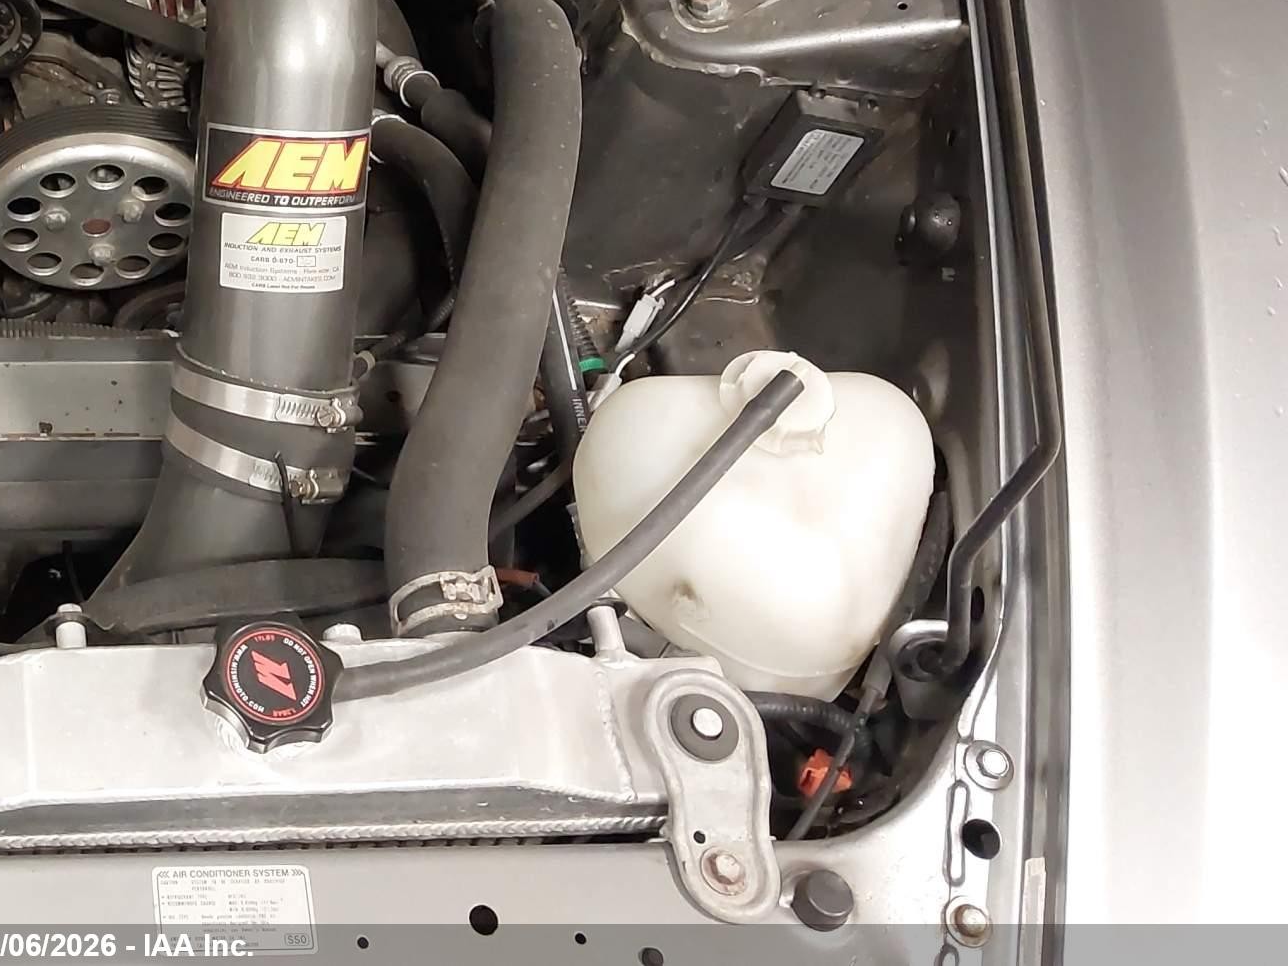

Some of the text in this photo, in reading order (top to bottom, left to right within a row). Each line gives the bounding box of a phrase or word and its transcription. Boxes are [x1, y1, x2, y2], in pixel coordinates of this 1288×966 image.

[211, 136, 368, 194] AEM
[209, 188, 270, 203] ENGINEERED
[274, 195, 290, 206] TO
[245, 221, 326, 246] AEM
[224, 242, 258, 252] INDUCTION
[315, 245, 342, 253] SYSTEMS
[283, 638, 317, 708] DO NOT OPEN WHEN HOT
[172, 869, 289, 878] AIR CONDITIONER SYSTEM
